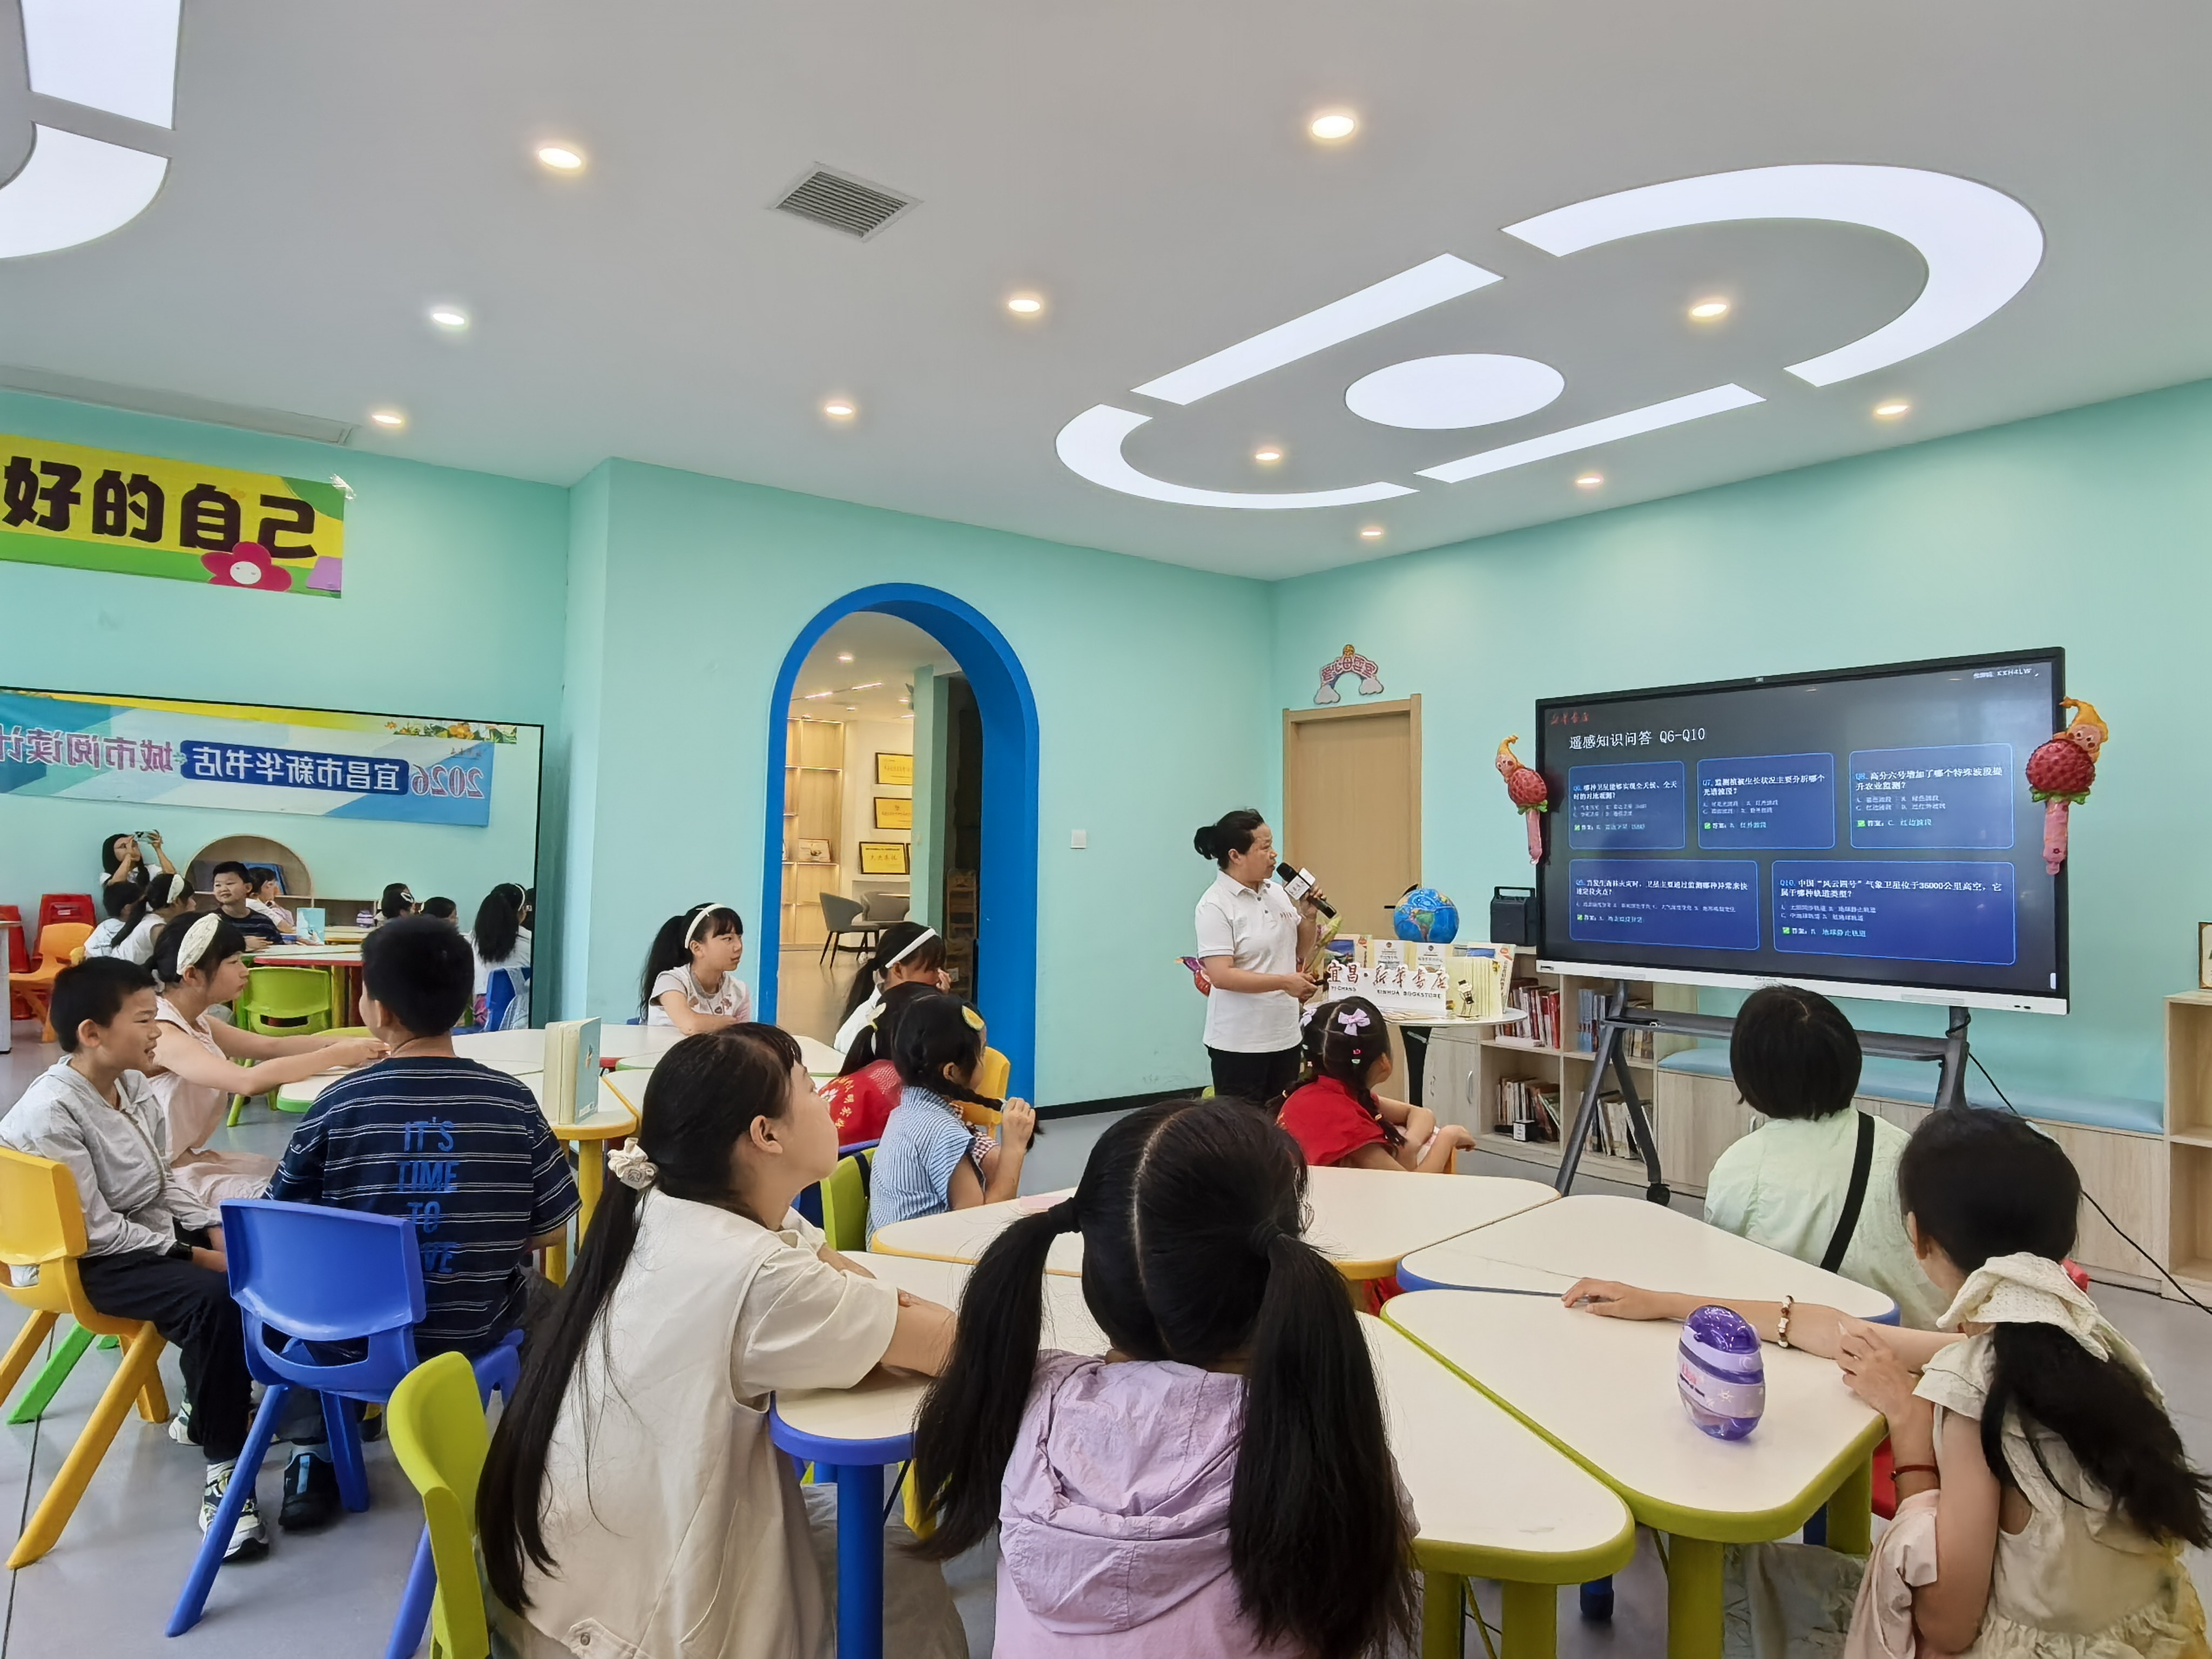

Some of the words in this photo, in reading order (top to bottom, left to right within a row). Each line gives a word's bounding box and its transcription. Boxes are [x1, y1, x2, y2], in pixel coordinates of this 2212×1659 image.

[2, 456, 318, 559] 好的自己
[1569, 730, 1653, 750] 遥感知识问答
[1659, 727, 1705, 744] Q6-Q10
[404, 1116, 455, 1152] IT'S
[396, 1160, 460, 1192] TIME
[407, 1201, 441, 1234] TO
